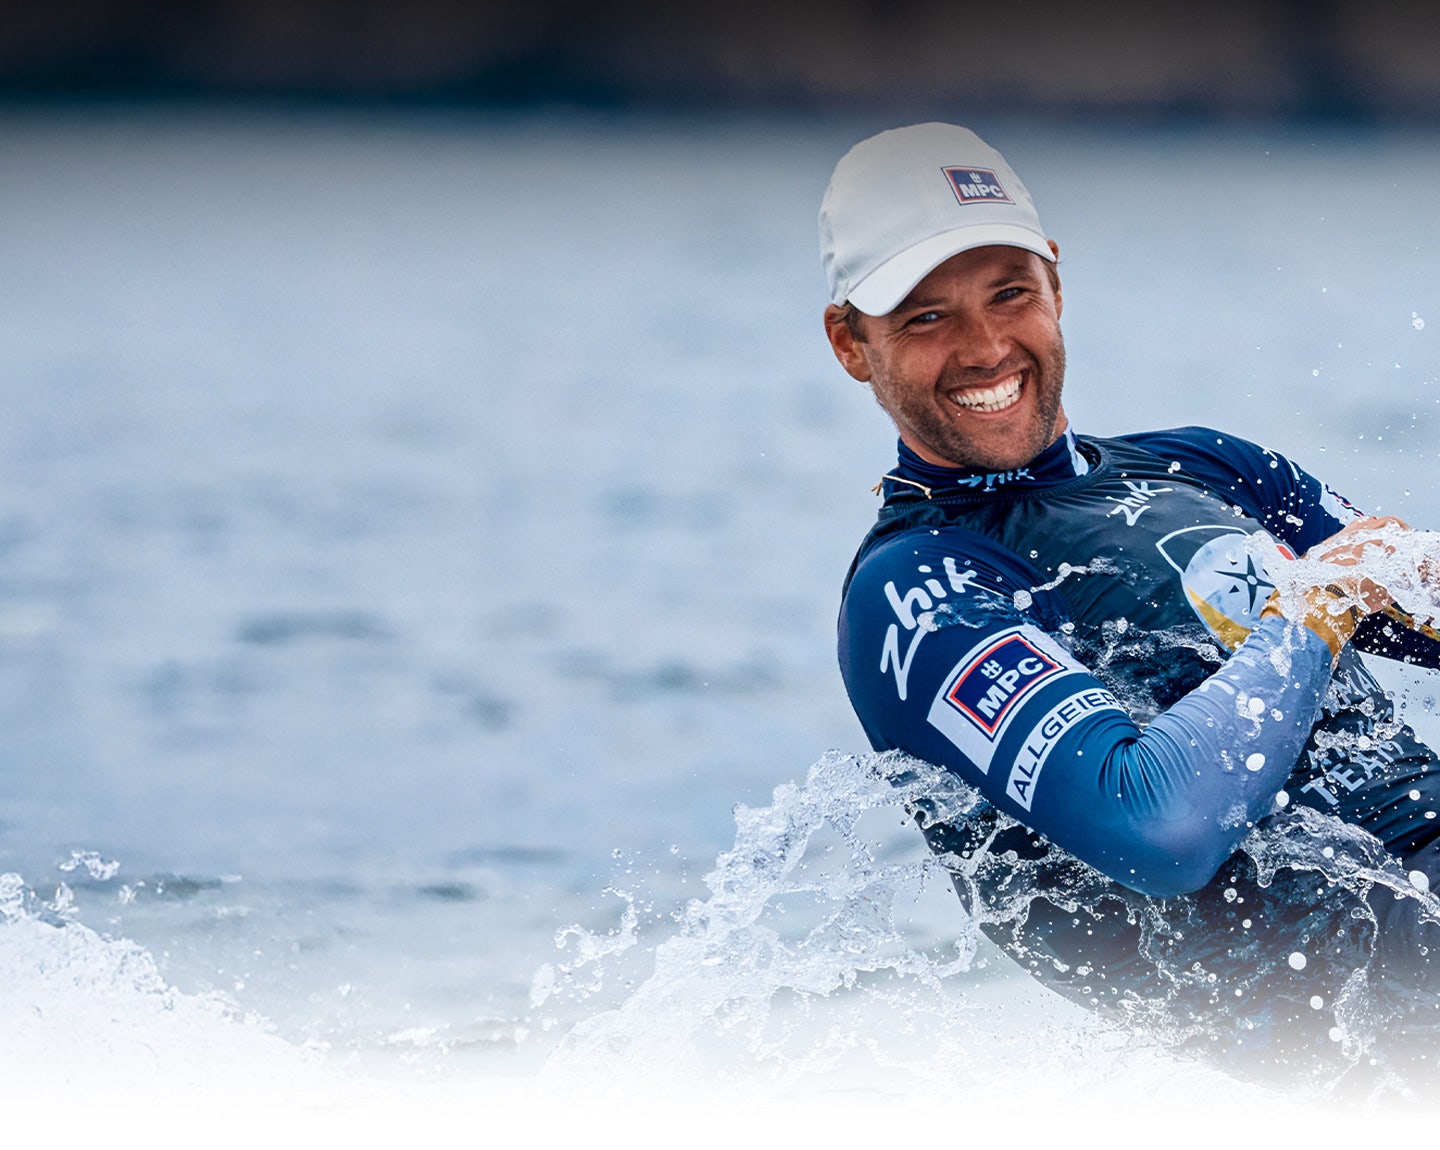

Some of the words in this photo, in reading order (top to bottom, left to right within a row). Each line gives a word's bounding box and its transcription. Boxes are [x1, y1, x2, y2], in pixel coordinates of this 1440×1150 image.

[958, 183, 1005, 198] MPC
[976, 657, 1044, 720] MPC
[1013, 691, 1118, 802] ALLGEIER
[1300, 740, 1405, 806] TEAM
